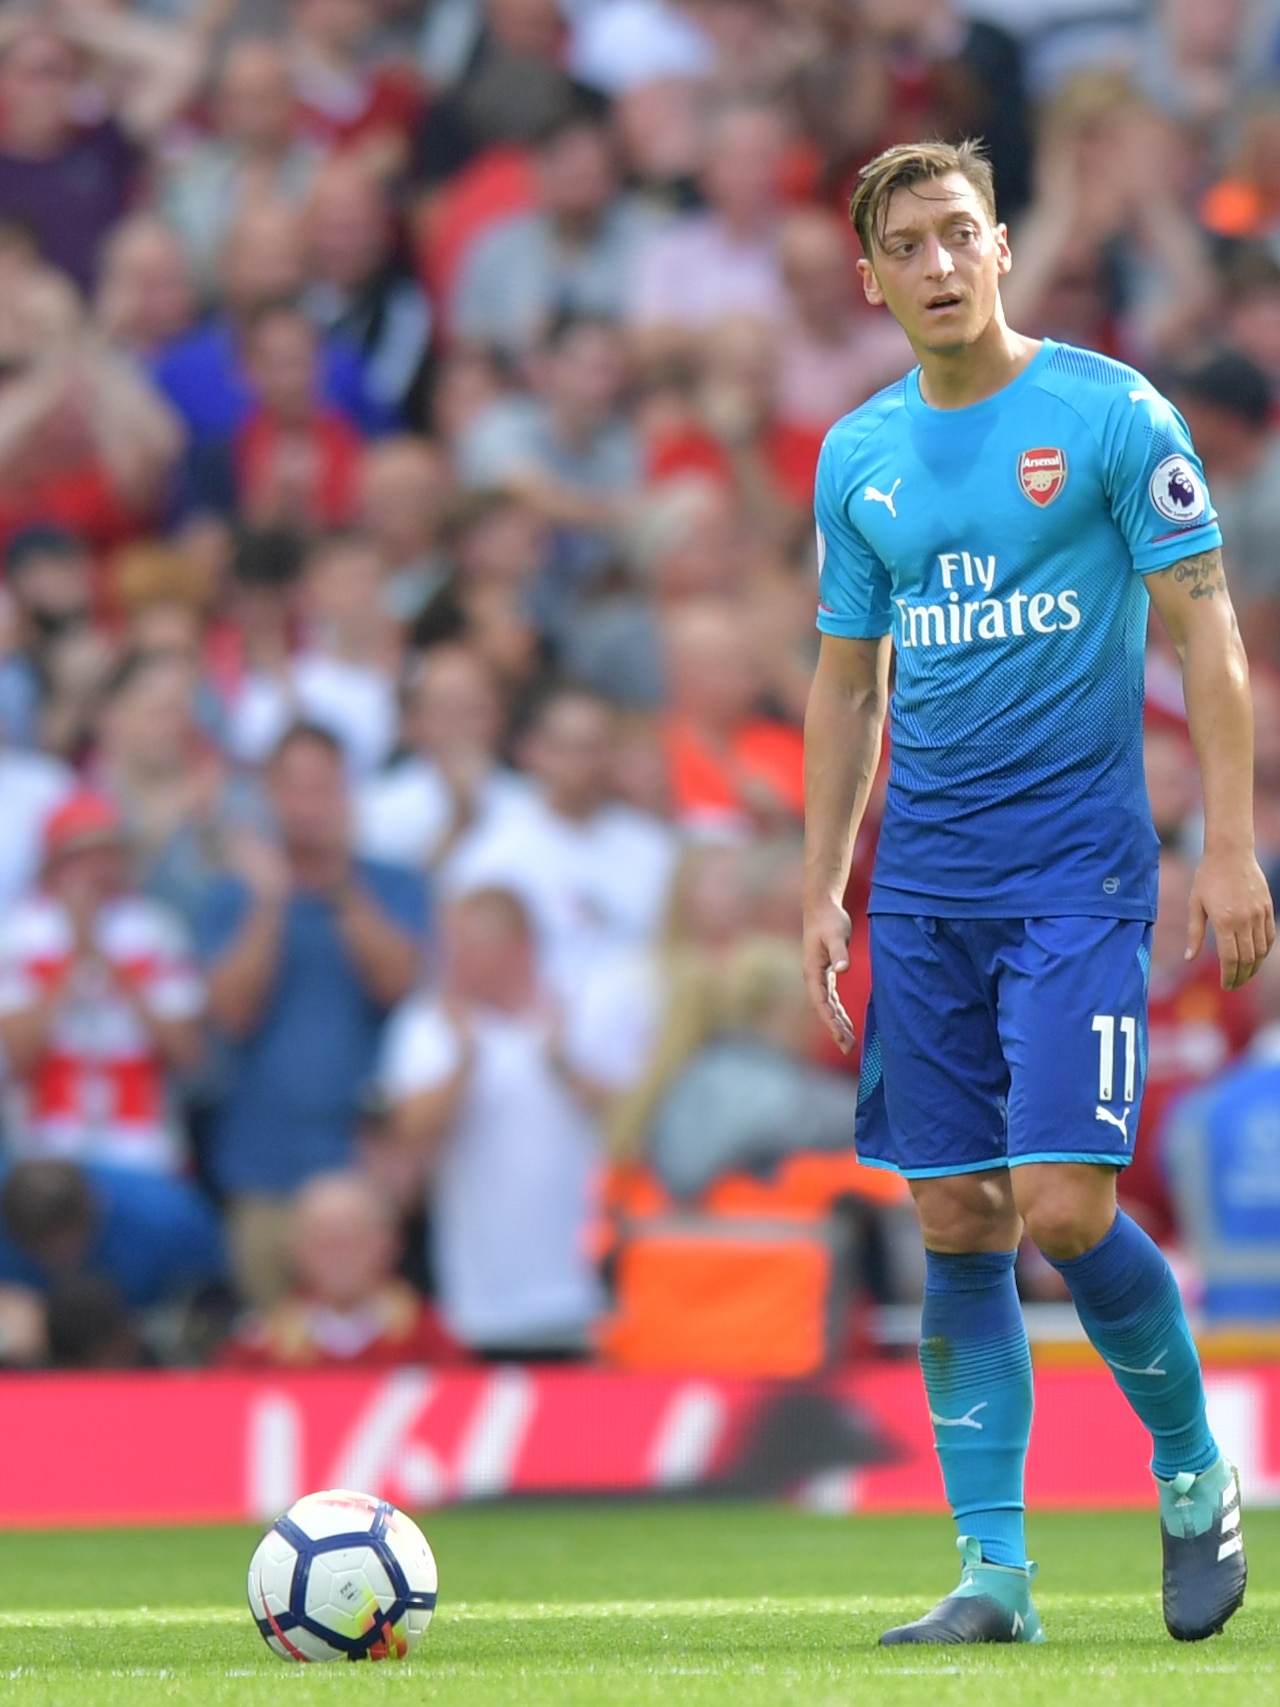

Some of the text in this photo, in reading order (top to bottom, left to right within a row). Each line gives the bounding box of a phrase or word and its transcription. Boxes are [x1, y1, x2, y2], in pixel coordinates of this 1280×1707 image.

[1025, 455, 1059, 467] Arsenal
[938, 552, 996, 591] Fly
[1091, 1015, 1135, 1102] 11
